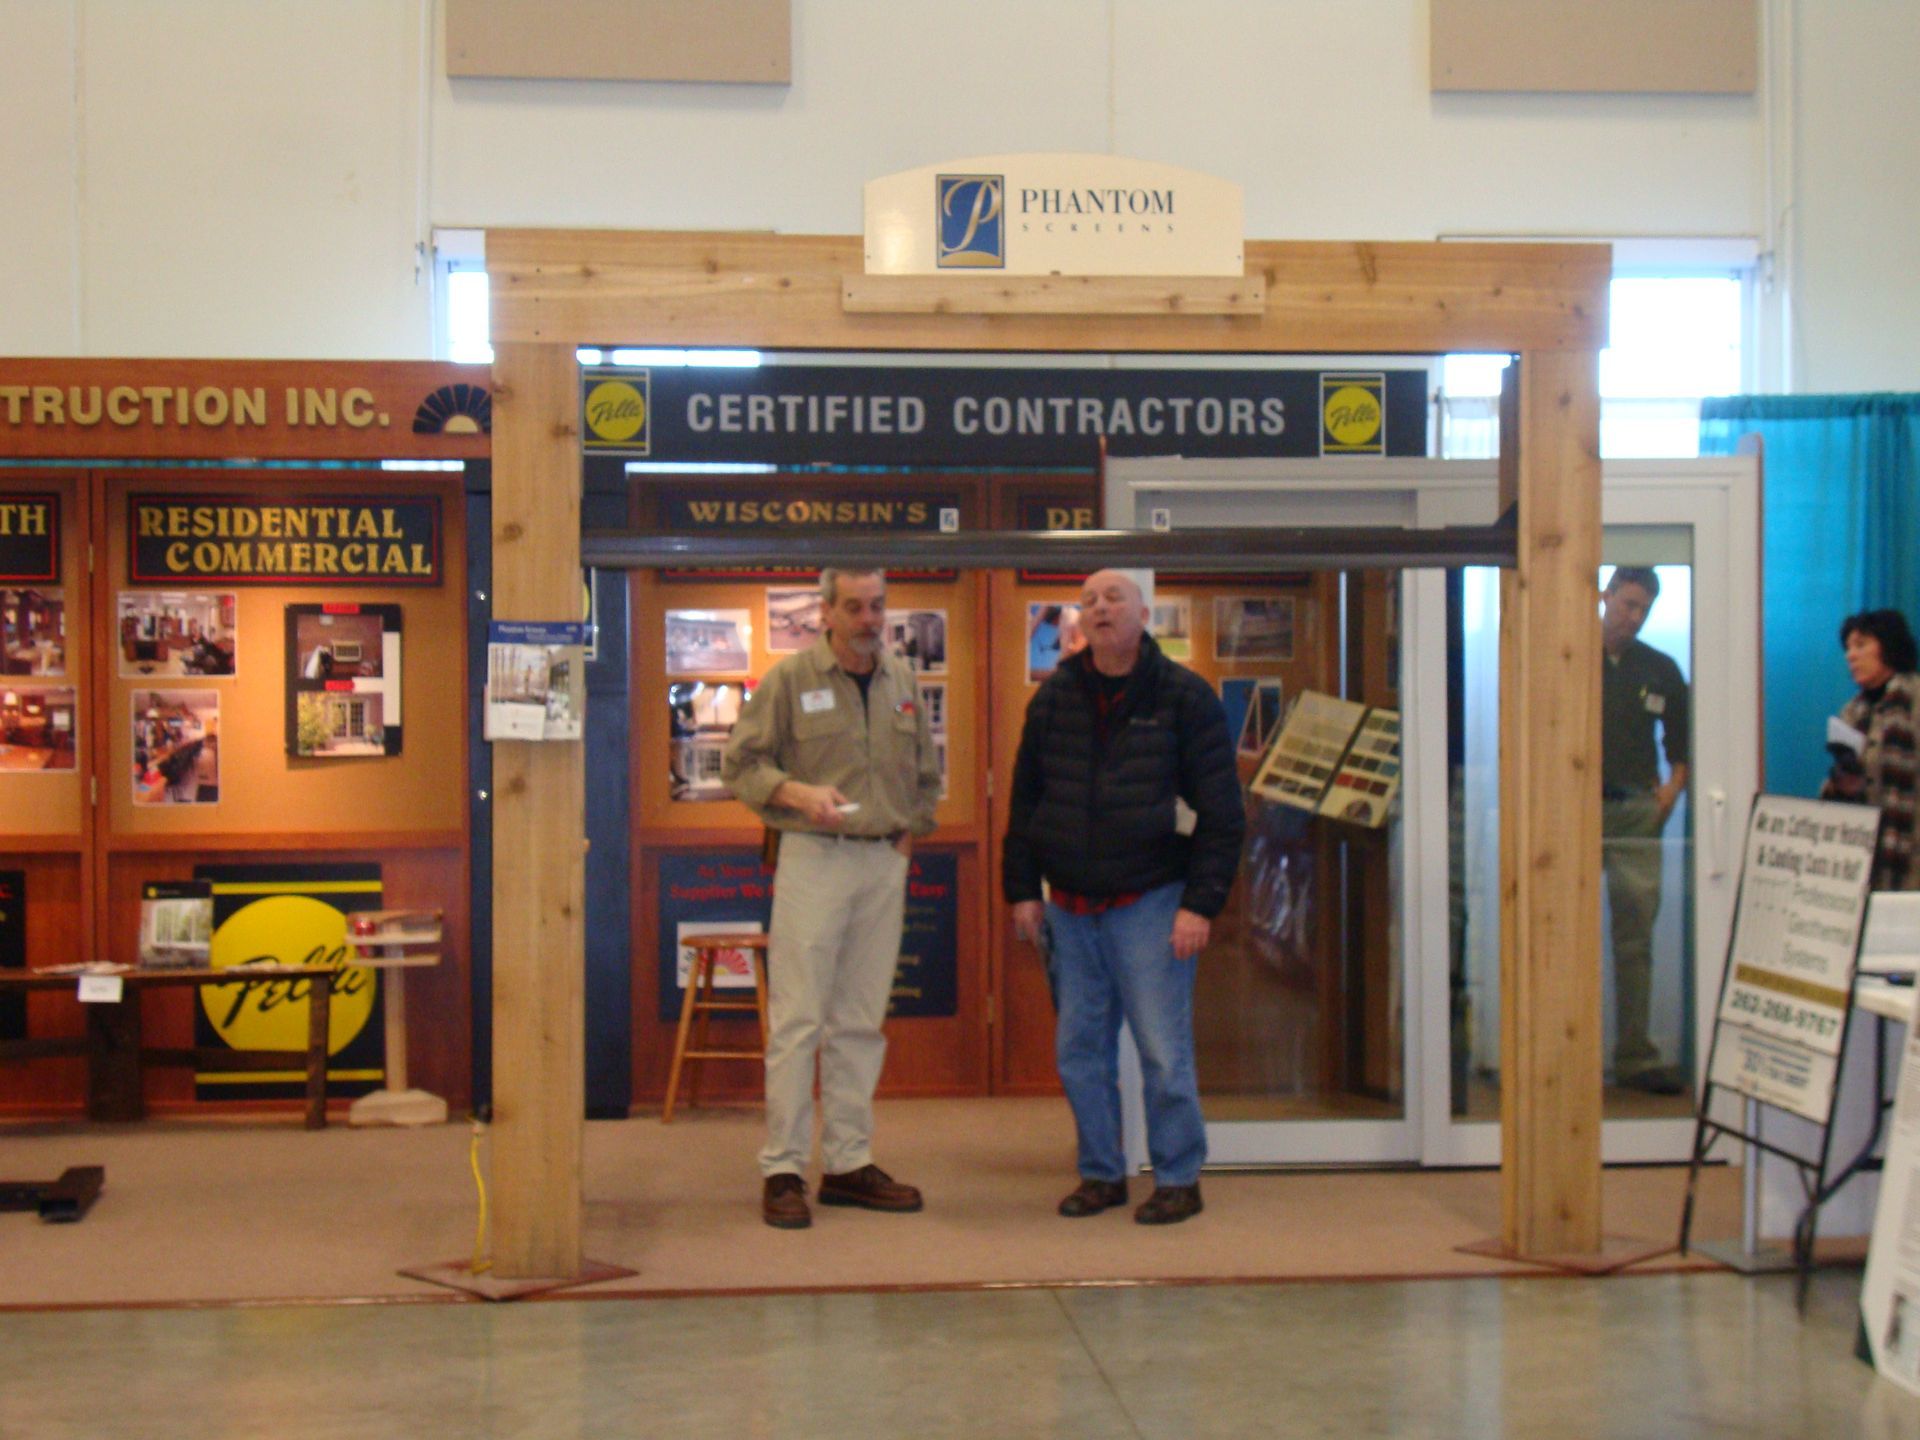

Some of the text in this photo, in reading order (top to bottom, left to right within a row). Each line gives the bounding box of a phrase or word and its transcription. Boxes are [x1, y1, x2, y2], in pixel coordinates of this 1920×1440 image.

[1020, 188, 1175, 215] PHANTOM
[1021, 222, 1175, 234] SCREENS
[0, 385, 391, 428] TRUCTION INC.
[686, 393, 1286, 437] CERTIFIED CONTRACTORS
[138, 505, 404, 539] RESIDENTIAL
[687, 500, 929, 524] WISCONSIN'S
[165, 541, 433, 576] COMMERCIAL
